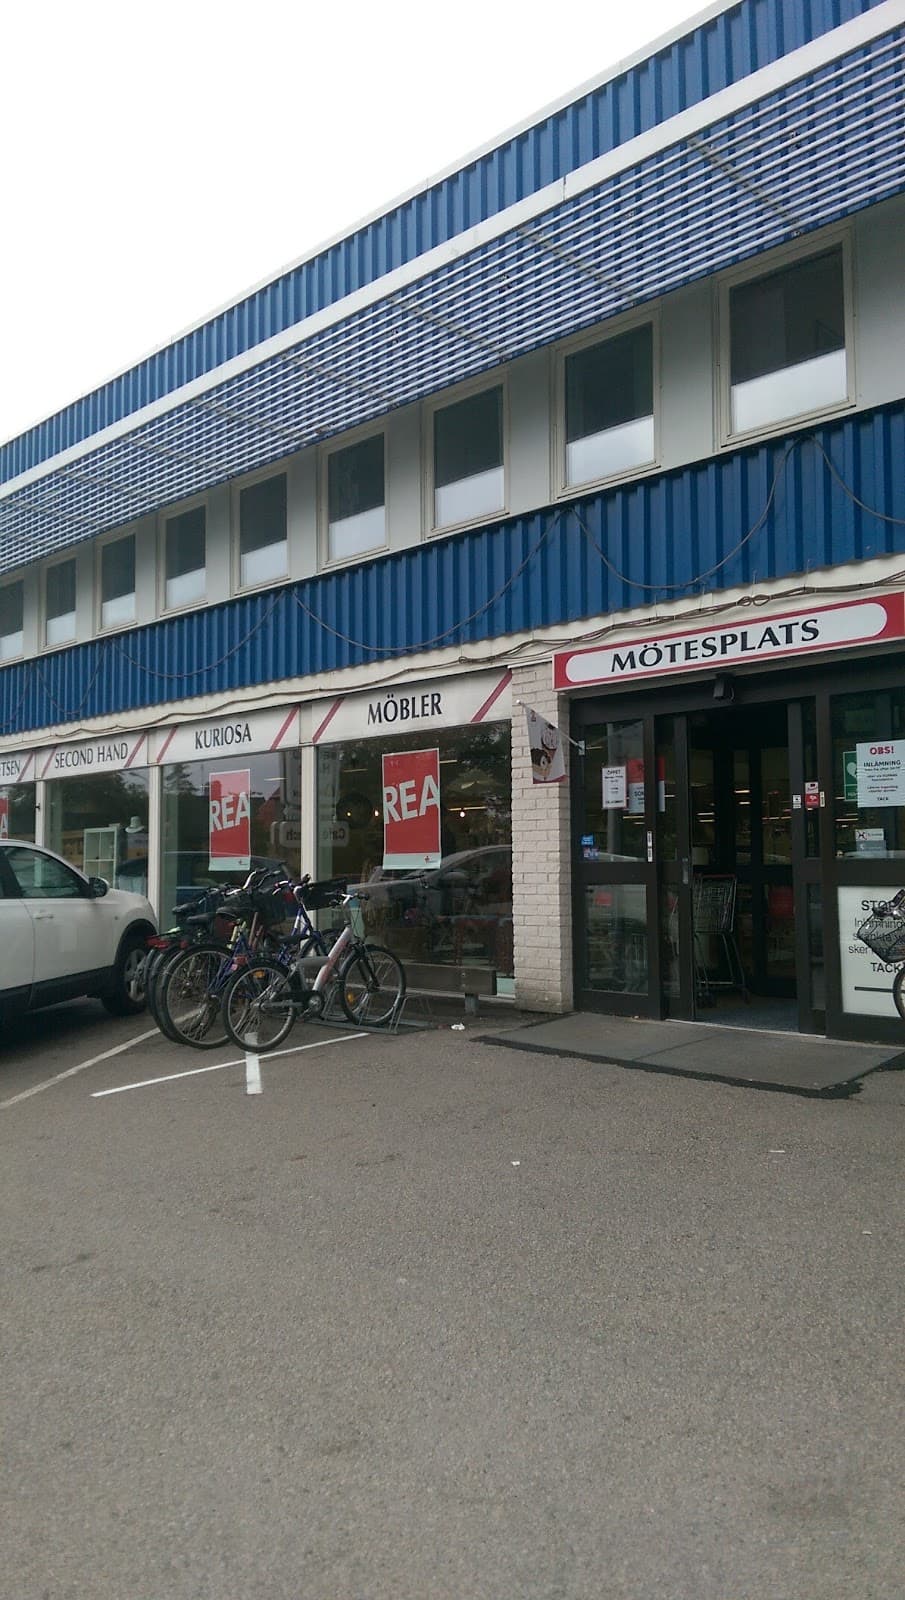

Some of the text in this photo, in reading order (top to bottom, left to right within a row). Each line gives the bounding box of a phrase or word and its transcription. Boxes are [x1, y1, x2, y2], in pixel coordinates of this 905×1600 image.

[611, 619, 819, 672] MÖTESPLATS
[367, 692, 442, 725] MÖBLER
[195, 723, 252, 750] KURIOSA
[869, 745, 895, 755] OBS!
[0, 760, 21, 776] TSEN
[54, 742, 128, 769] SECOND HAND
[209, 791, 250, 833] REA
[383, 774, 440, 825] REA
